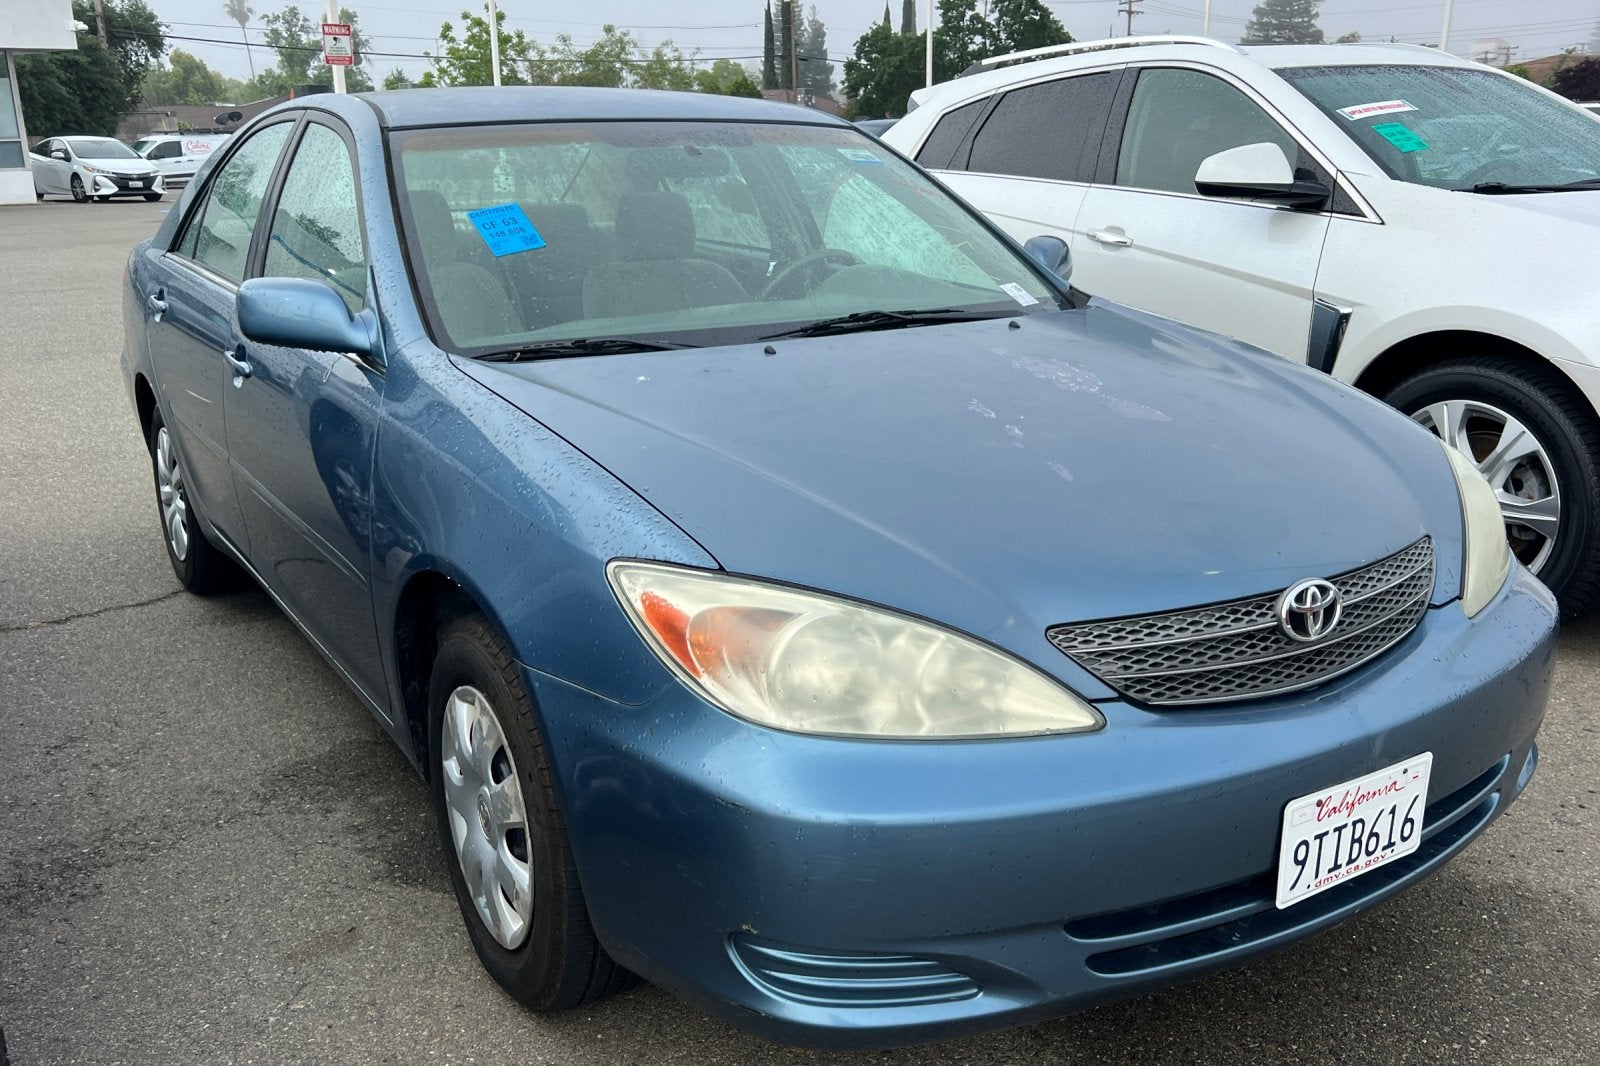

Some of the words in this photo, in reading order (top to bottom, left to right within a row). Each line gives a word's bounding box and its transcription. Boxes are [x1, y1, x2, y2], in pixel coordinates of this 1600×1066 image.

[323, 25, 350, 35] WARNING
[482, 221, 497, 230] CF
[502, 217, 518, 227] 63
[1316, 780, 1405, 822] California
[1289, 794, 1420, 891] 9TIB616
[1314, 852, 1388, 888] dmv.ca.gov
